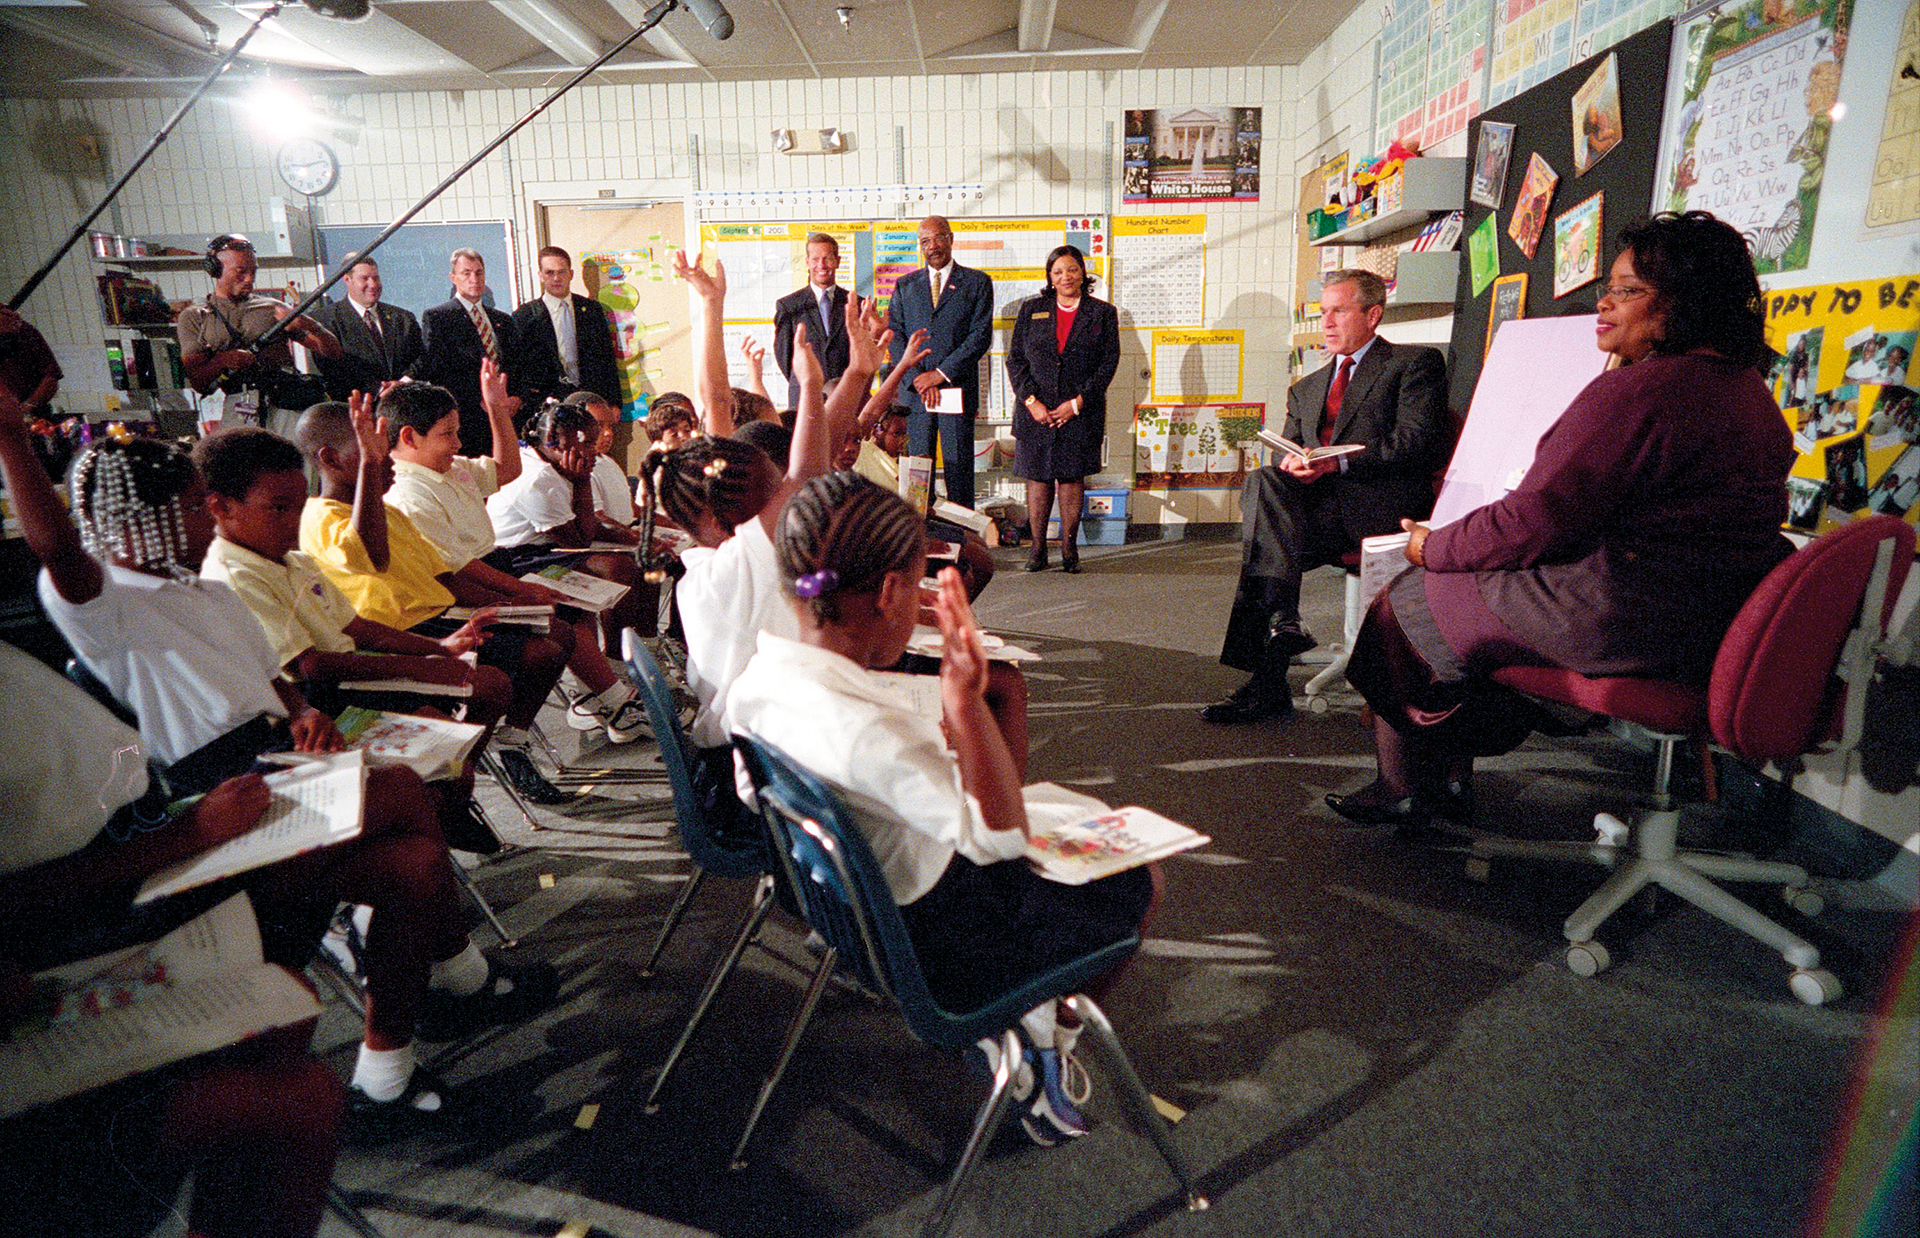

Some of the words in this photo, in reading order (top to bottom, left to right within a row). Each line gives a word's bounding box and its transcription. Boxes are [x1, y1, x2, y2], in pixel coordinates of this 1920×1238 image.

[1714, 76, 1730, 92] Aa
[1761, 55, 1777, 74] Cc
[1786, 41, 1806, 64] Dd
[1711, 100, 1726, 118] Ee
[1751, 84, 1770, 106] Gg
[1776, 71, 1798, 92] Hh
[1727, 115, 1740, 141] Jj
[1745, 107, 1764, 130] Kk
[1772, 99, 1786, 120] Ll
[1701, 149, 1722, 165] Mm
[1728, 138, 1742, 158] Nn
[1750, 132, 1770, 150] Oo
[1776, 124, 1795, 148] Pp
[1712, 168, 1730, 190] Qq
[1737, 160, 1752, 178] Rr
[1759, 154, 1775, 173] Ss
[1150, 184, 1189, 194] White
[1192, 184, 1232, 194] House
[1714, 191, 1730, 208] Uu
[1758, 176, 1788, 198] Ww
[983, 222, 1029, 230] Temperatures
[1748, 204, 1766, 224] Zz
[884, 243, 912, 251] February
[1757, 290, 1817, 319] PPY
[1828, 286, 1862, 314] TO
[1878, 280, 1920, 309] BE
[1162, 336, 1180, 344] Daily
[1184, 335, 1234, 343] Temperatures
[1155, 419, 1198, 436] Tree
